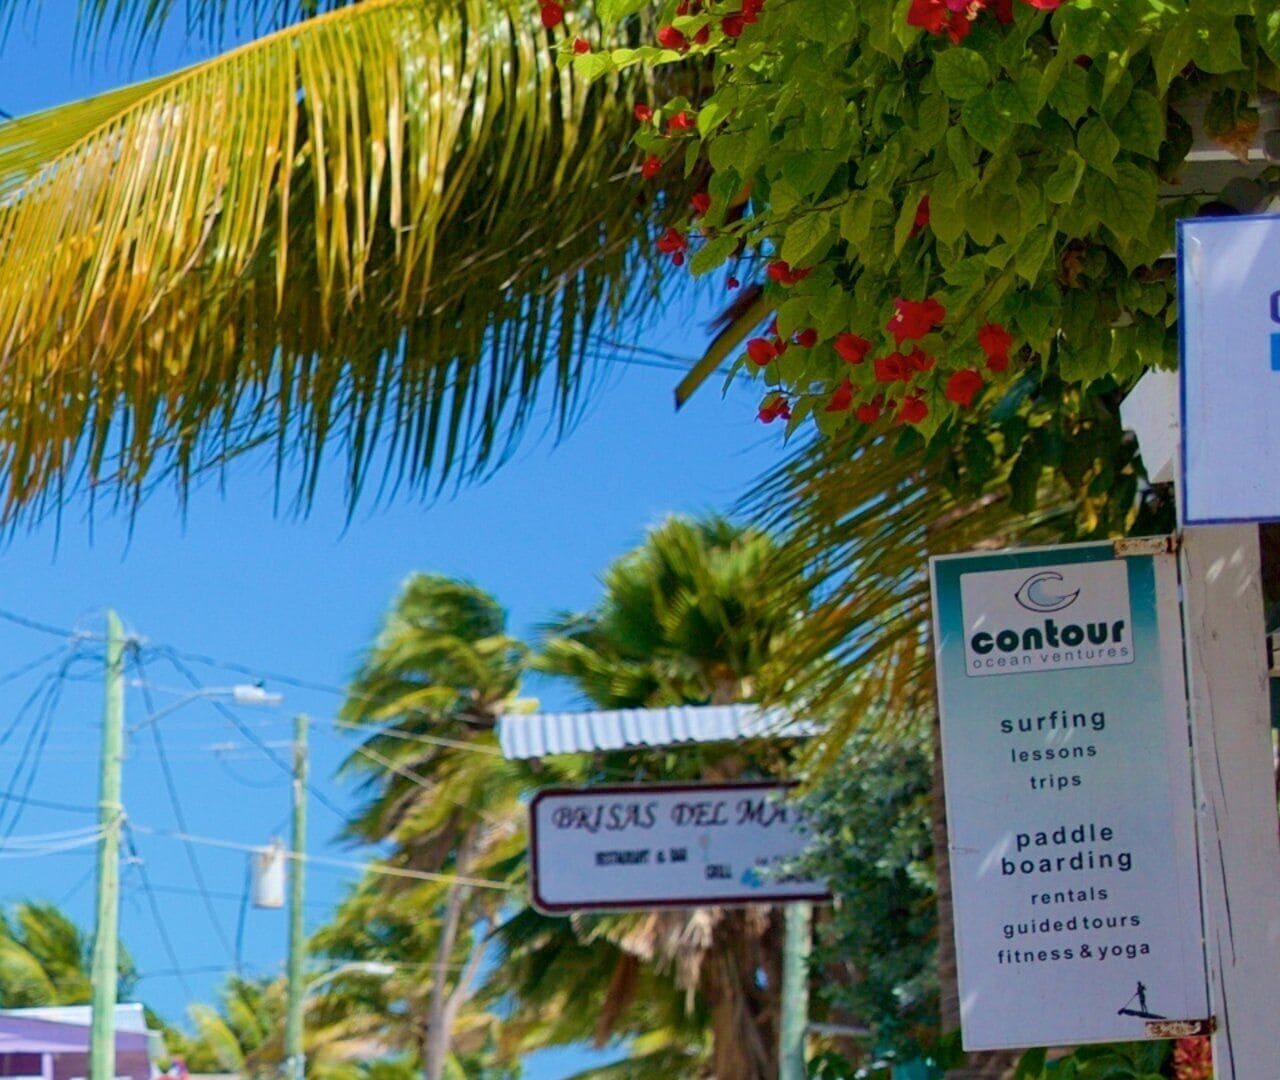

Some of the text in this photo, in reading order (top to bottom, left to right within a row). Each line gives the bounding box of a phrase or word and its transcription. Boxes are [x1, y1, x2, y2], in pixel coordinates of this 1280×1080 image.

[971, 619, 1125, 654] contour
[973, 646, 1129, 669] ocean ventures
[1001, 711, 1106, 734] surfing
[1011, 744, 1097, 763] lessons
[1030, 774, 1082, 790] trips
[552, 797, 805, 833] BRISAS DEL MA
[1016, 824, 1114, 851] paddle
[1001, 851, 1133, 876] boarding
[1031, 887, 1108, 905] rentals
[998, 942, 1150, 964] fitness & yoga
